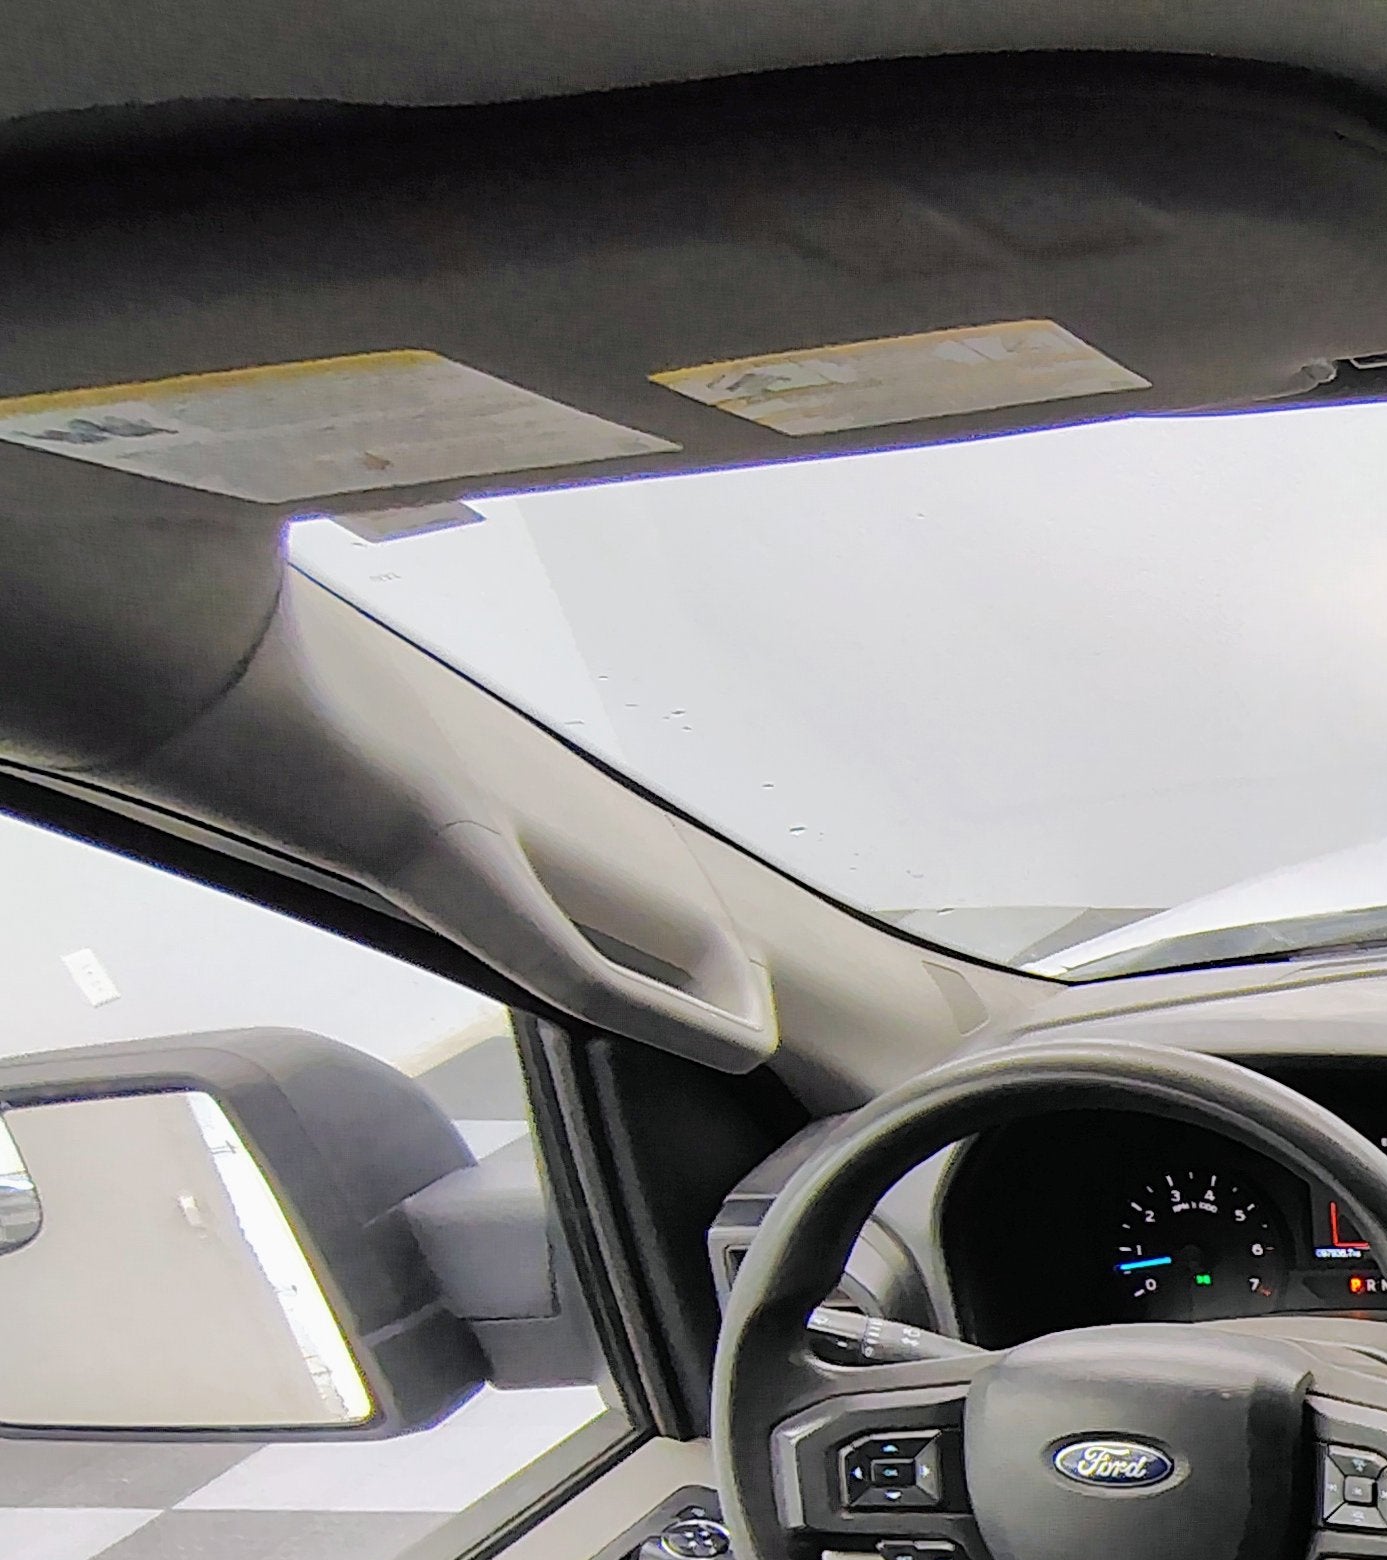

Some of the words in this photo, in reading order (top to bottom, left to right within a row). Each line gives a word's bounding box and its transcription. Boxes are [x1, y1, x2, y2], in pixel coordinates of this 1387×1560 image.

[1171, 1190, 1180, 1202] 3
[1204, 1190, 1215, 1201] 4
[1145, 1210, 1156, 1222] 2
[1235, 1209, 1246, 1222] 5
[1136, 1244, 1143, 1256] 1
[1252, 1243, 1263, 1256] 6
[1145, 1278, 1157, 1291] 0
[1249, 1278, 1259, 1291] 7
[1350, 1278, 1361, 1292] P
[1366, 1278, 1377, 1292] R
[1077, 1446, 1148, 1478] Ford
